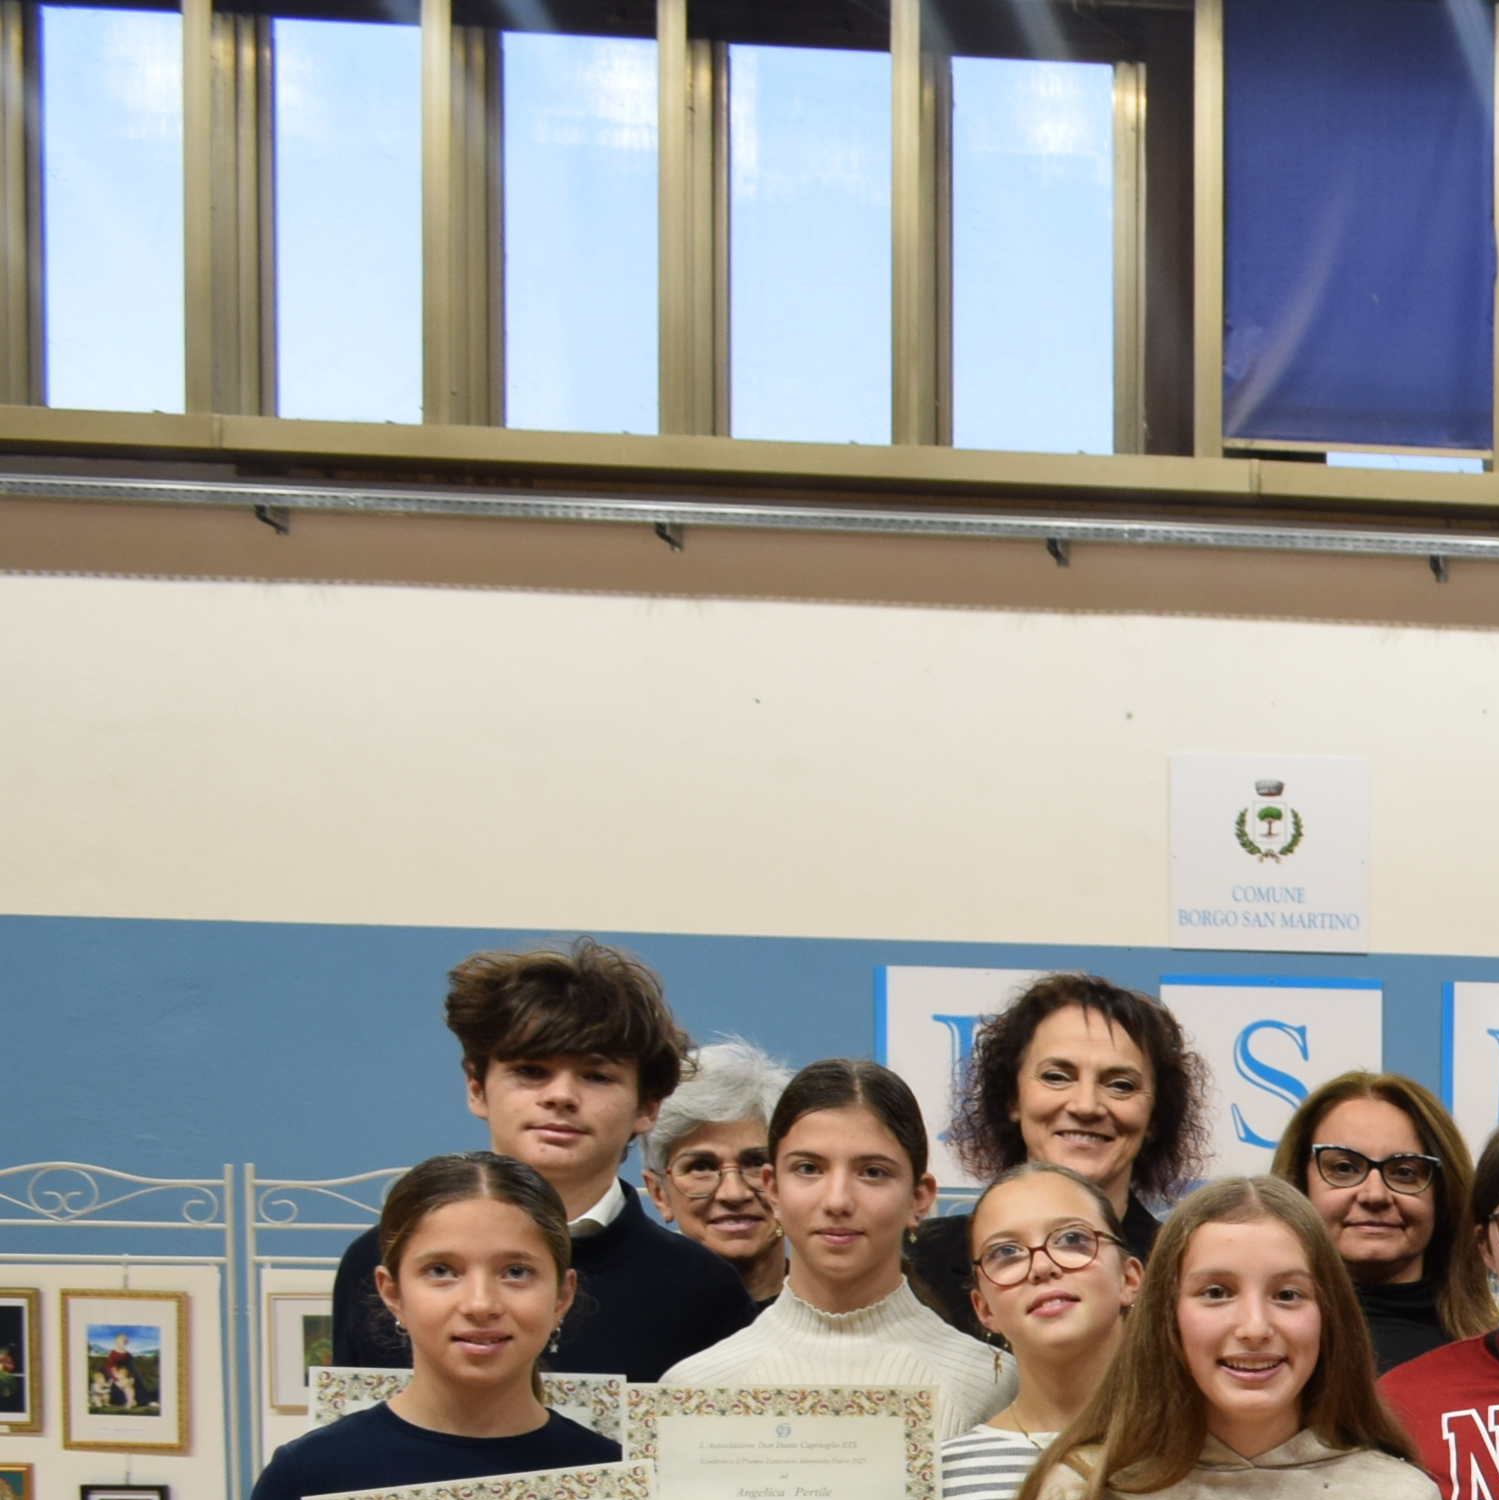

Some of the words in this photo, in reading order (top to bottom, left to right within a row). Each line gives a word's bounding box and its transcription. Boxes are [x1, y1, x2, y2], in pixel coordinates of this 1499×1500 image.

[1231, 885, 1306, 904] COMUNE
[1177, 909, 1238, 928] BORGO
[1242, 911, 1275, 929] SAN
[1280, 912, 1360, 930] MARTINO
[1231, 1019, 1310, 1150] S
[736, 1488, 785, 1499] Angelica
[795, 1487, 833, 1497] Pertile
